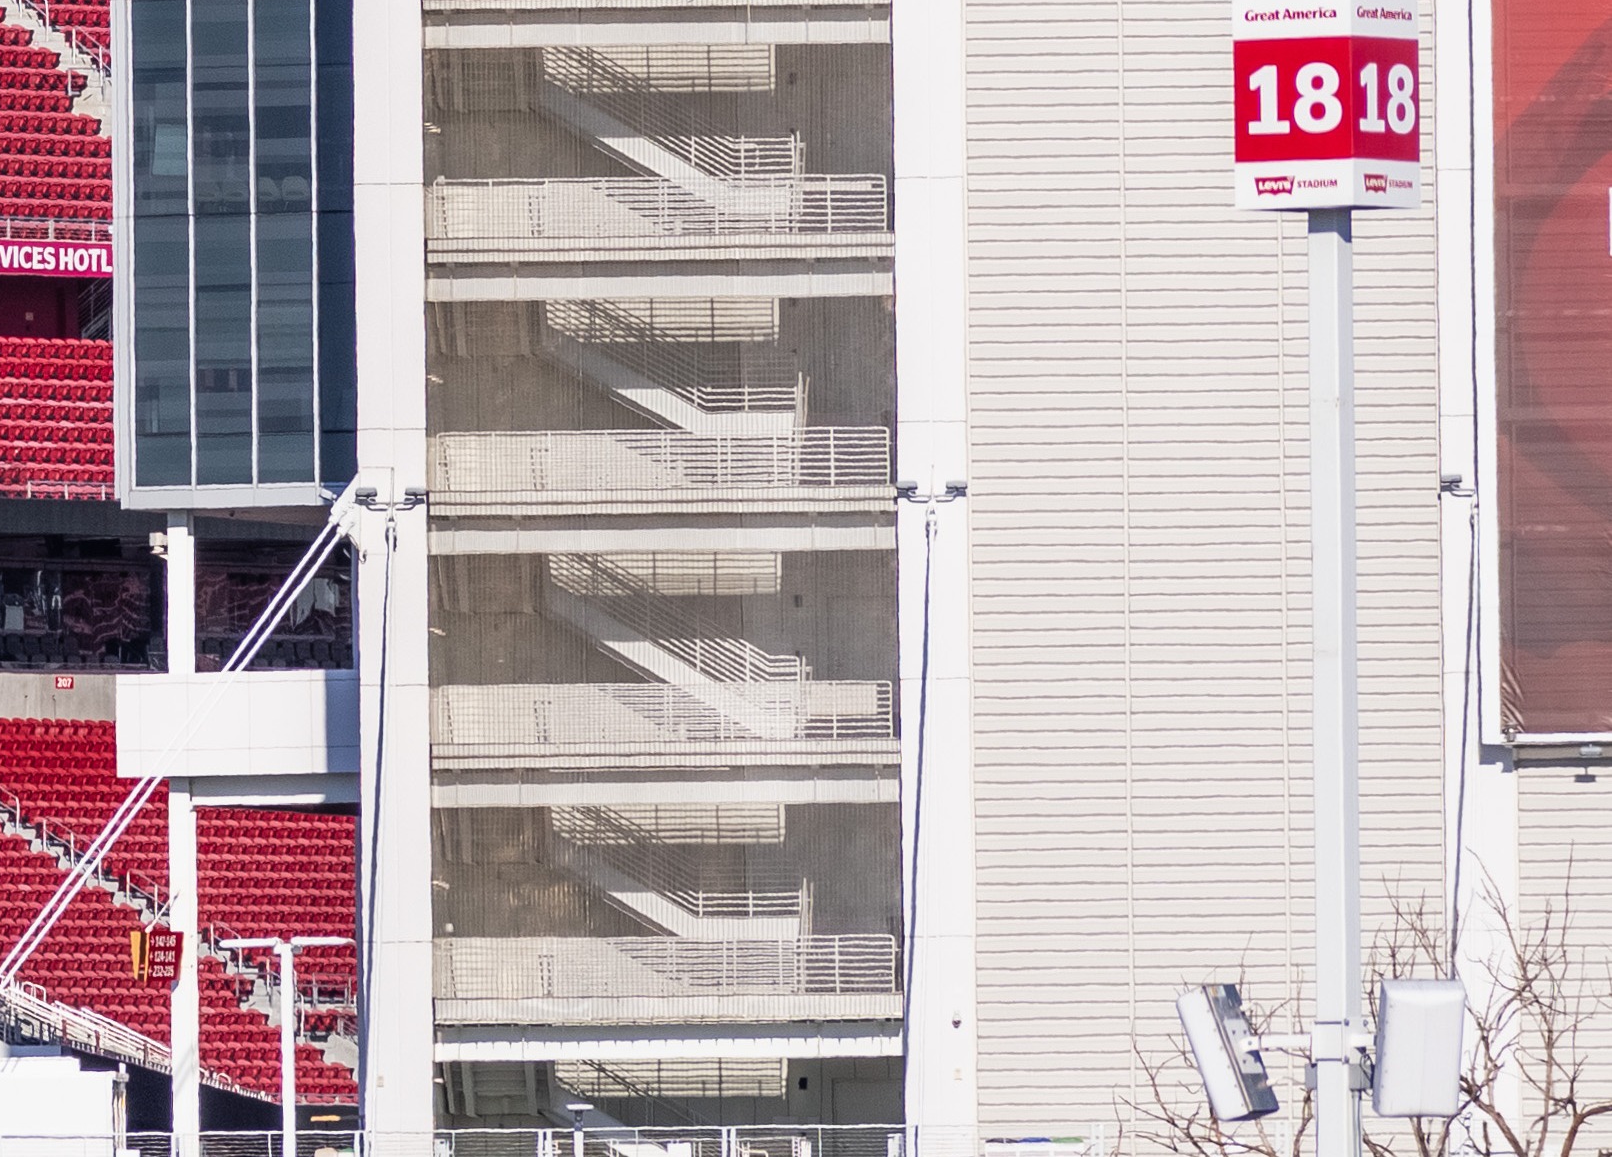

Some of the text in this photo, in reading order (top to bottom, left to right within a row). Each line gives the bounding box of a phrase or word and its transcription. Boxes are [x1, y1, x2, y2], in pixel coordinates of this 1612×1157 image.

[1245, 7, 1337, 22] Great America
[1357, 6, 1413, 21] Great America
[1248, 62, 1343, 135] 18
[1359, 62, 1416, 135] 18
[1296, 178, 1338, 189] STADIUM
[1388, 179, 1413, 189] STADIUM
[57, 677, 72, 688] 207
